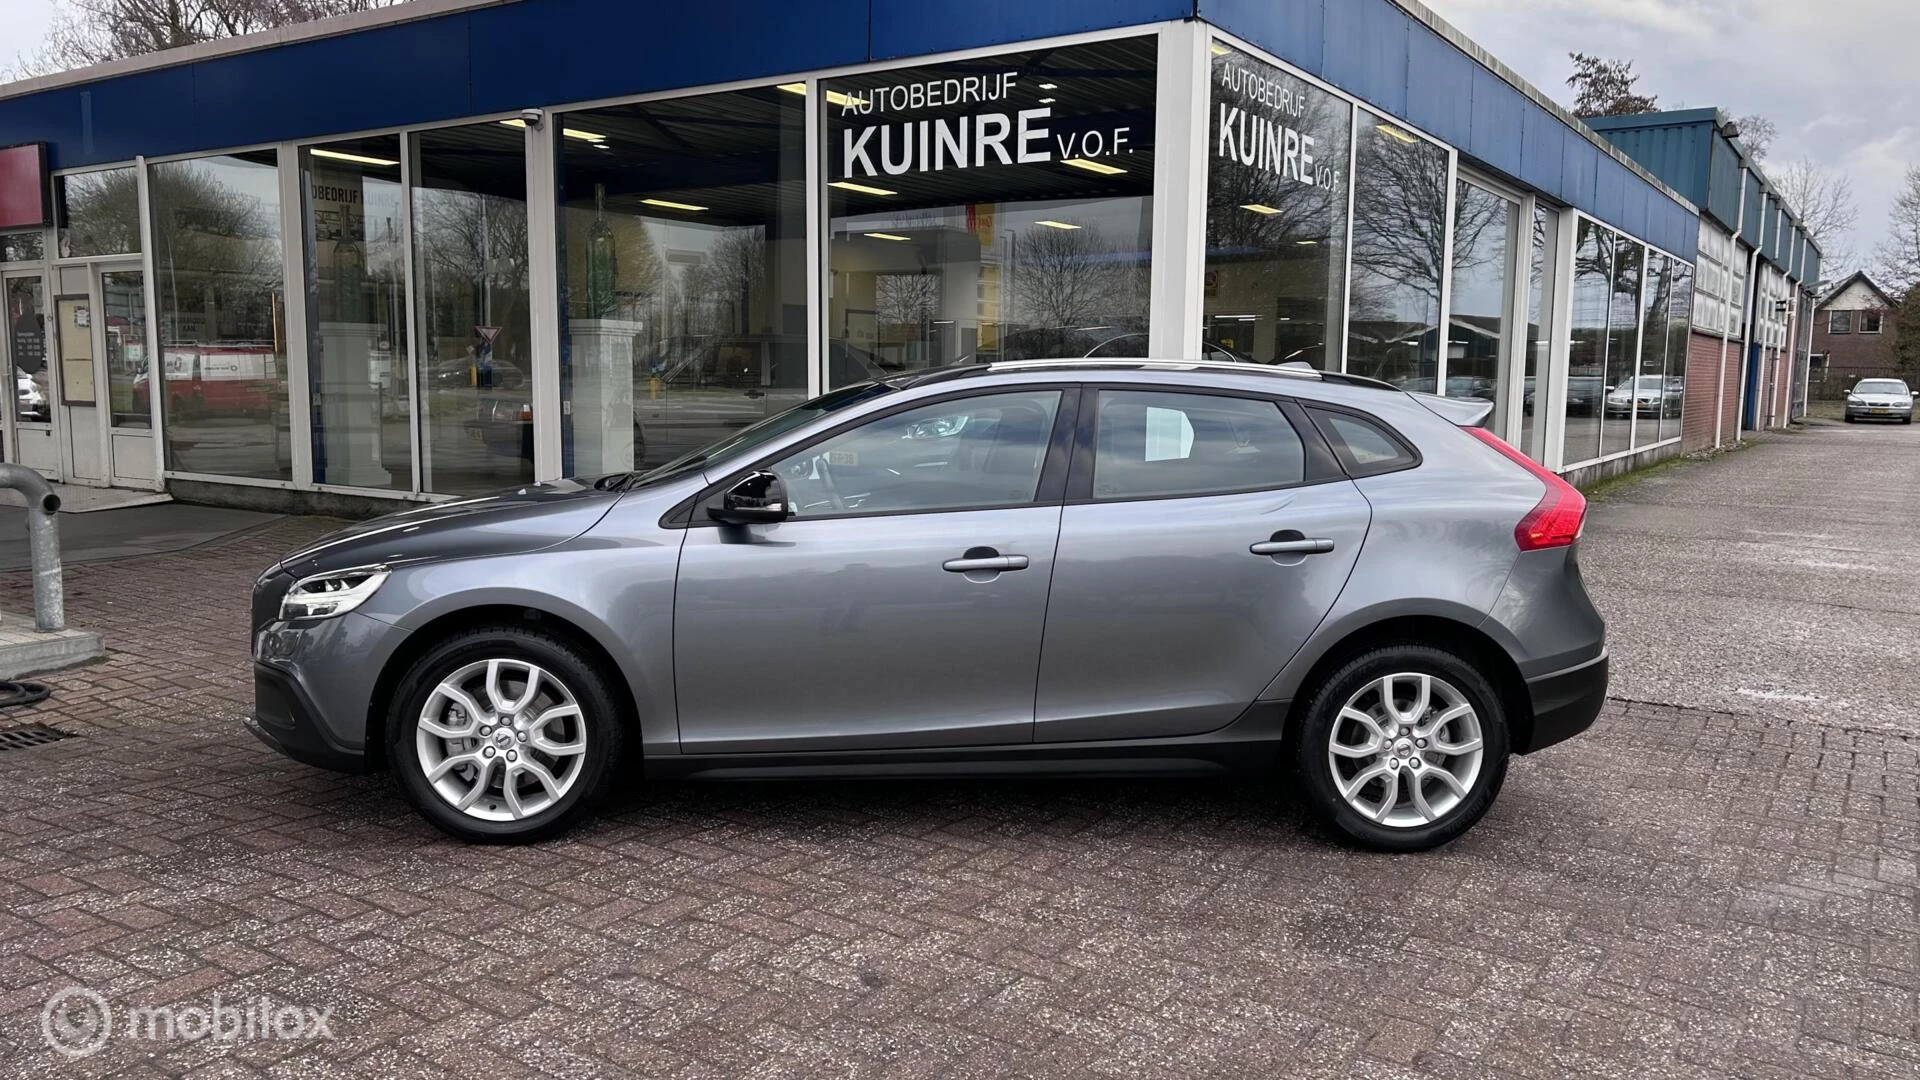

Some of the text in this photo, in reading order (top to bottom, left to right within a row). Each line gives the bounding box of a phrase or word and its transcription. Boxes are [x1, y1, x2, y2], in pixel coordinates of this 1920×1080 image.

[841, 71, 1018, 116] AUTOBEDRIJF
[1222, 62, 1305, 118] AUTOBEDRIJF
[1056, 127, 1134, 159] V.O.F.
[1218, 102, 1314, 185] KUINRE
